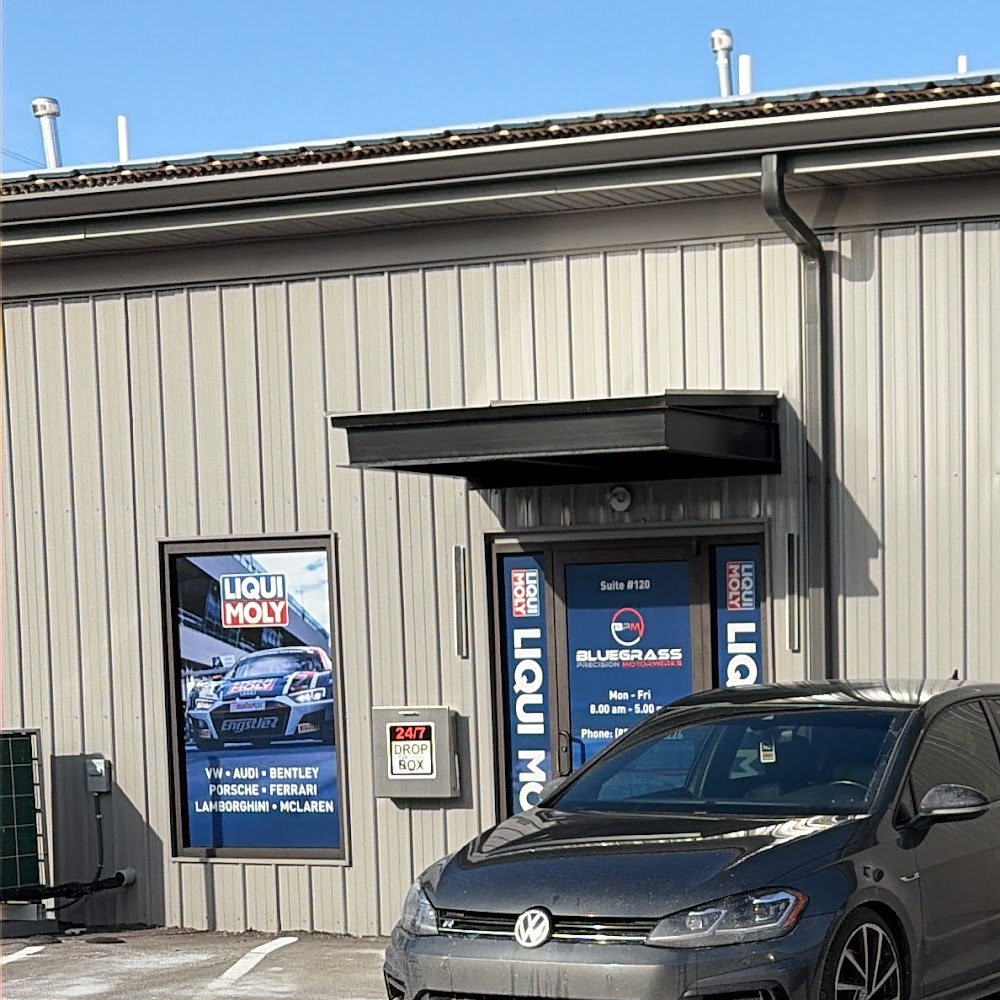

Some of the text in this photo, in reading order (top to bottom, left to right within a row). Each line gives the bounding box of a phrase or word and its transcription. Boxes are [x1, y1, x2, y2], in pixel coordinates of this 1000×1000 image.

[224, 575, 284, 600] LIQUI
[600, 579, 651, 591] Suite #120
[728, 563, 740, 608] MOLY
[741, 563, 754, 607] LIQUI
[513, 572, 526, 616] MOLY
[525, 571, 538, 614] LIQUI
[225, 601, 286, 625] MOLY
[613, 622, 641, 631] BPM
[575, 648, 683, 662] BLUEGRASS
[726, 622, 758, 687] LIQ
[609, 689, 629, 700] Mon
[637, 689, 652, 700] Fri
[589, 704, 610, 714] 8.00
[612, 706, 627, 714] am
[634, 703, 655, 714] 5.00
[513, 628, 546, 811] LIQUI MO
[395, 726, 426, 739] 24/7
[581, 728, 613, 739] Phone:
[394, 744, 428, 754] DROP
[398, 760, 424, 771] BOX
[205, 767, 319, 779] VW AUDI BENTLEY
[209, 784, 317, 796] PORSCHE FERRARI
[195, 800, 334, 813] LAMBORGHINI MCLAREN
